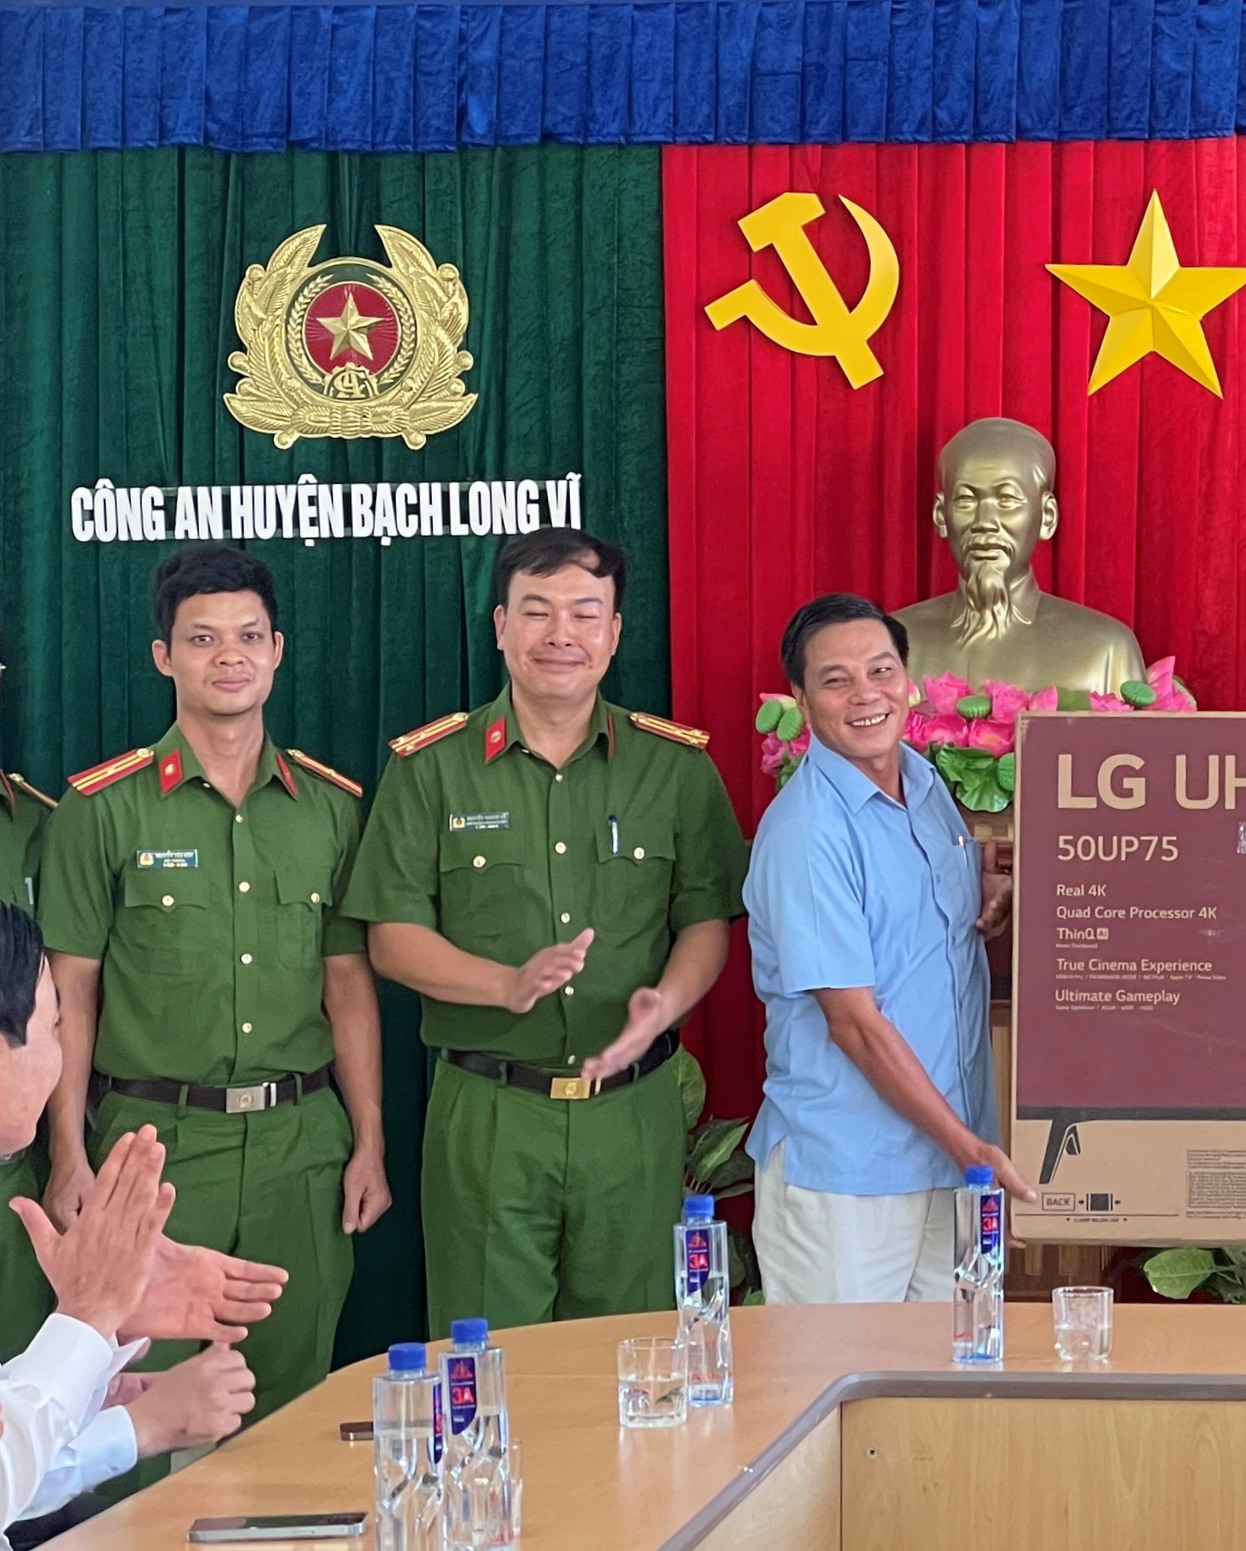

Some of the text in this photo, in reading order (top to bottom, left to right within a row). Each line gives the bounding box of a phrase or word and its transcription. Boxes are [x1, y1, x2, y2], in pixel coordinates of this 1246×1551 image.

[71, 471, 582, 547] CÔNG AN HUYỆN BẠCH LONG VĨ
[1057, 753, 1146, 810] LG
[1057, 835, 1179, 862] 50UP75
[1056, 884, 1107, 897] Real 4K
[1056, 905, 1218, 919] Quad Core Processor 4K
[1056, 927, 1095, 940] ThinQ
[1056, 958, 1213, 975] True Cinema Experience
[1055, 989, 1181, 1006] Ultimate Gameplay
[1046, 1197, 1071, 1207] BACK
